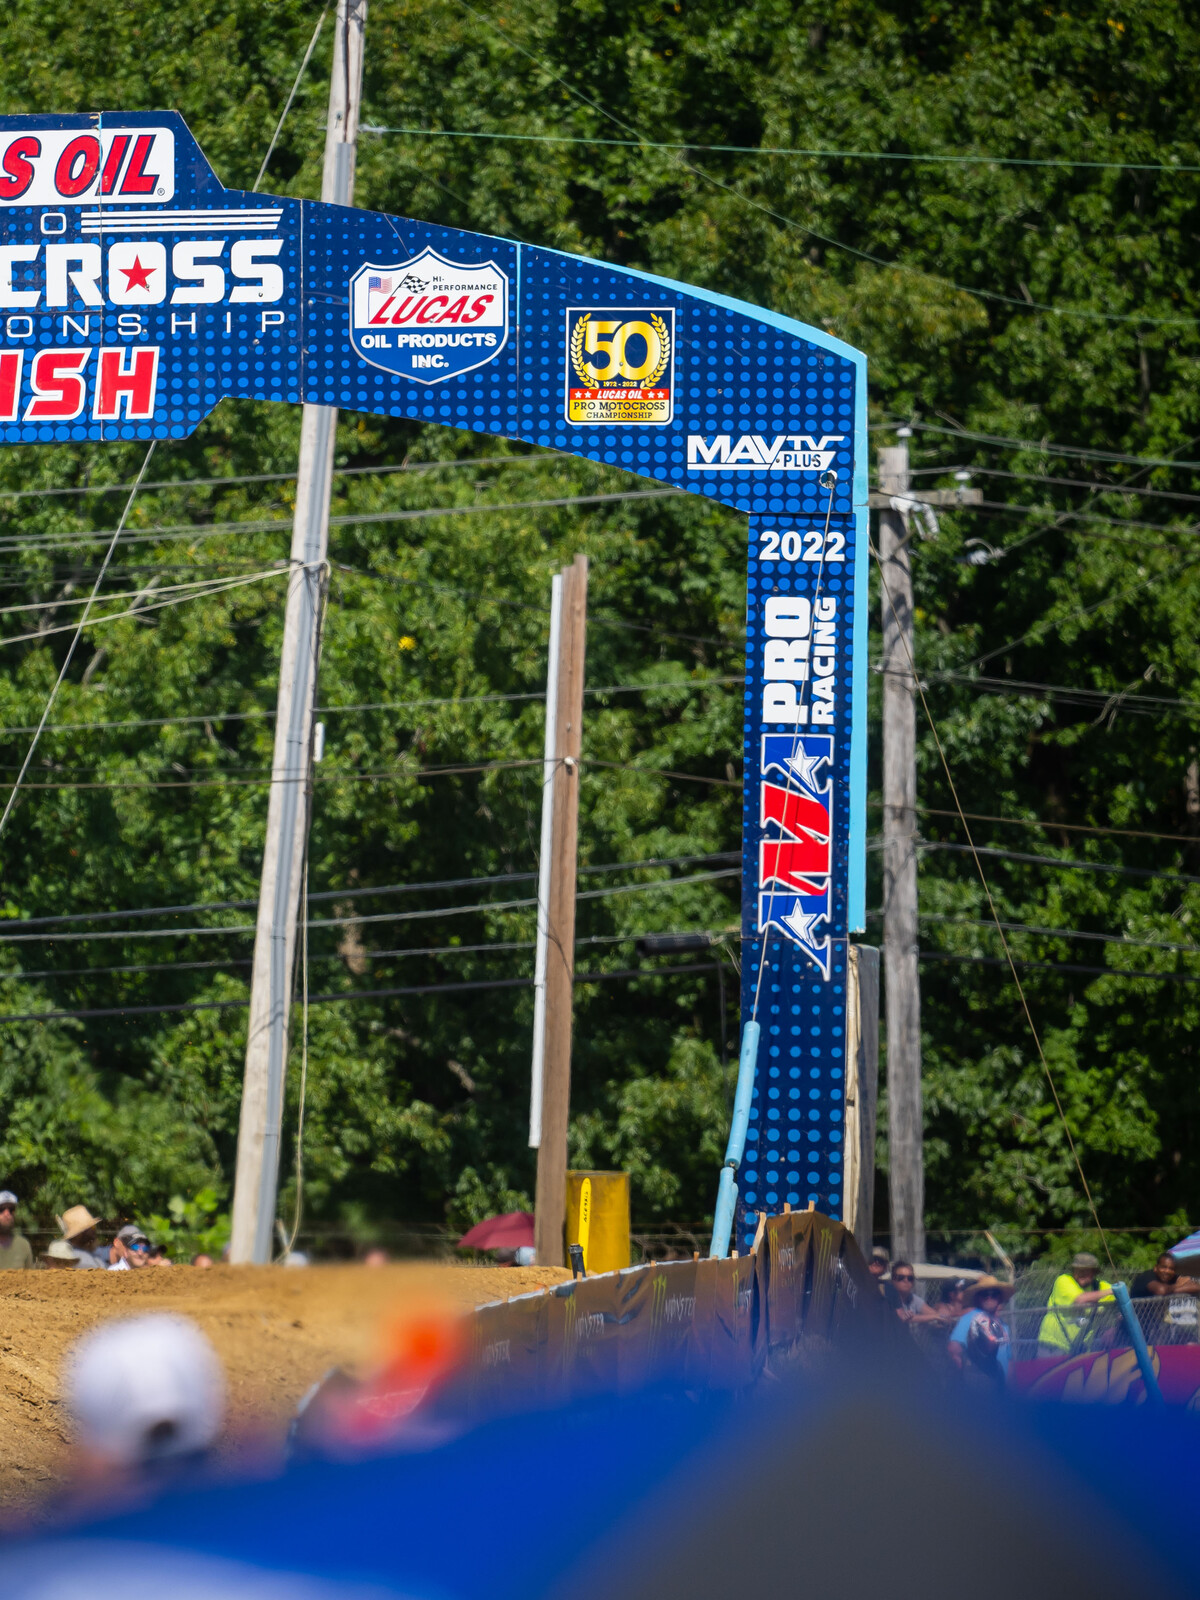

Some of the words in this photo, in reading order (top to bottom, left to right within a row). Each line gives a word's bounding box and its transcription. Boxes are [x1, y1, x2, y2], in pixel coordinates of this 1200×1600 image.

[54, 134, 160, 198] OIL
[432, 283, 498, 291] PERFORMANCE
[369, 294, 495, 325] LUCAS
[360, 334, 392, 349] OIL
[397, 333, 497, 348] PRODUCTS
[582, 320, 661, 381] 50
[573, 401, 596, 411] PRO
[599, 401, 666, 411] MOTOCROSS
[596, 390, 627, 400] LUCAS
[627, 390, 643, 399] OIL
[586, 411, 653, 419] CHAMPIONSHIP
[687, 435, 845, 464] MAVTV
[783, 453, 822, 468] PLUS
[758, 530, 846, 562] 2022
[762, 596, 811, 724] PRO
[811, 597, 837, 725] RACING
